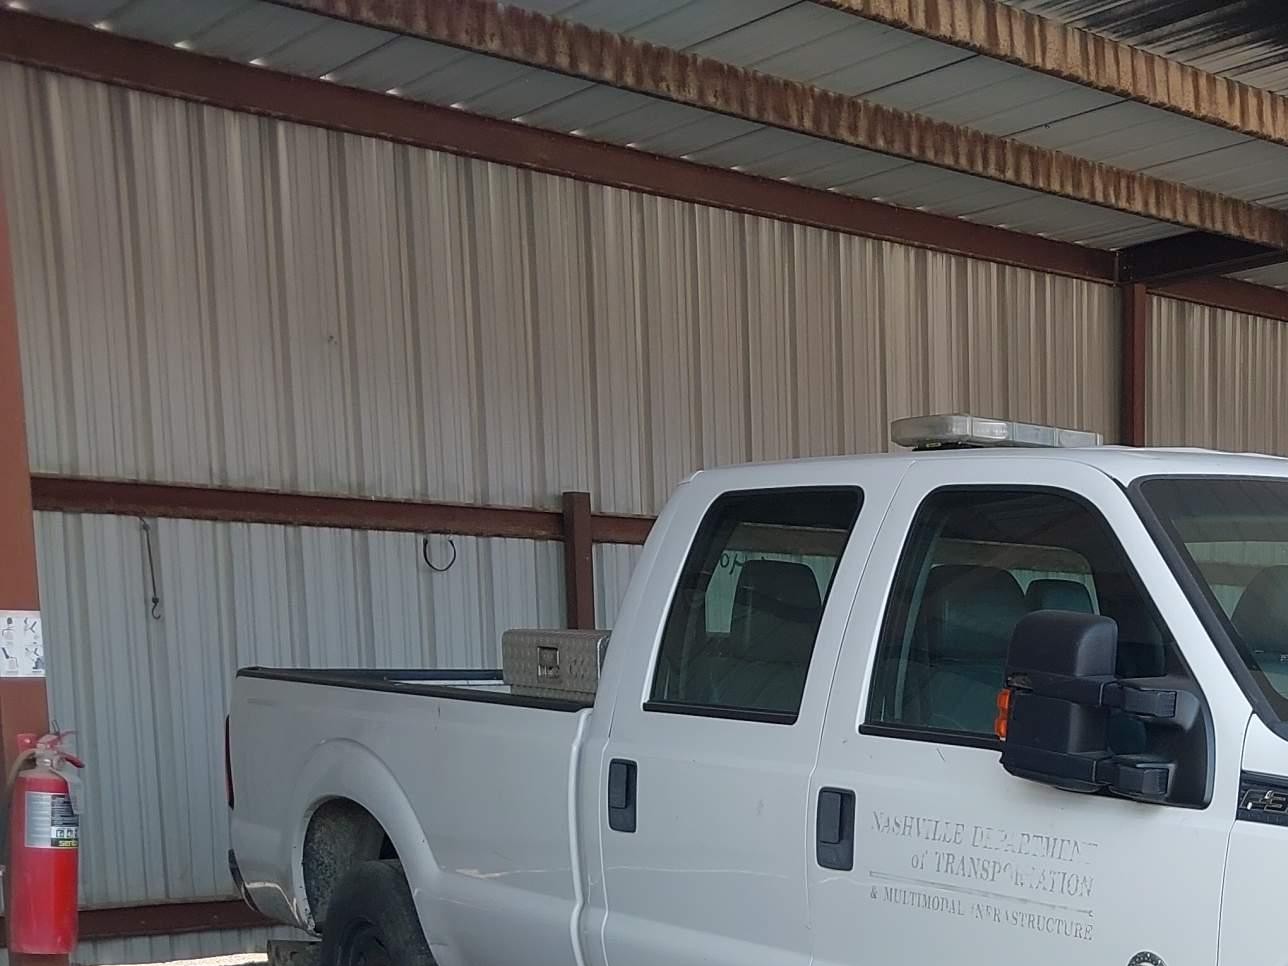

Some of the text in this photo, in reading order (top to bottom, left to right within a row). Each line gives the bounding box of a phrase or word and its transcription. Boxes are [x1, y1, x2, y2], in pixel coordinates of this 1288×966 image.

[871, 810, 1099, 864] NASHVILLE DEPRTMEN
[911, 849, 1095, 896] of TRANSPORATION
[869, 885, 879, 899] &
[883, 886, 965, 916] MULTIMODAL
